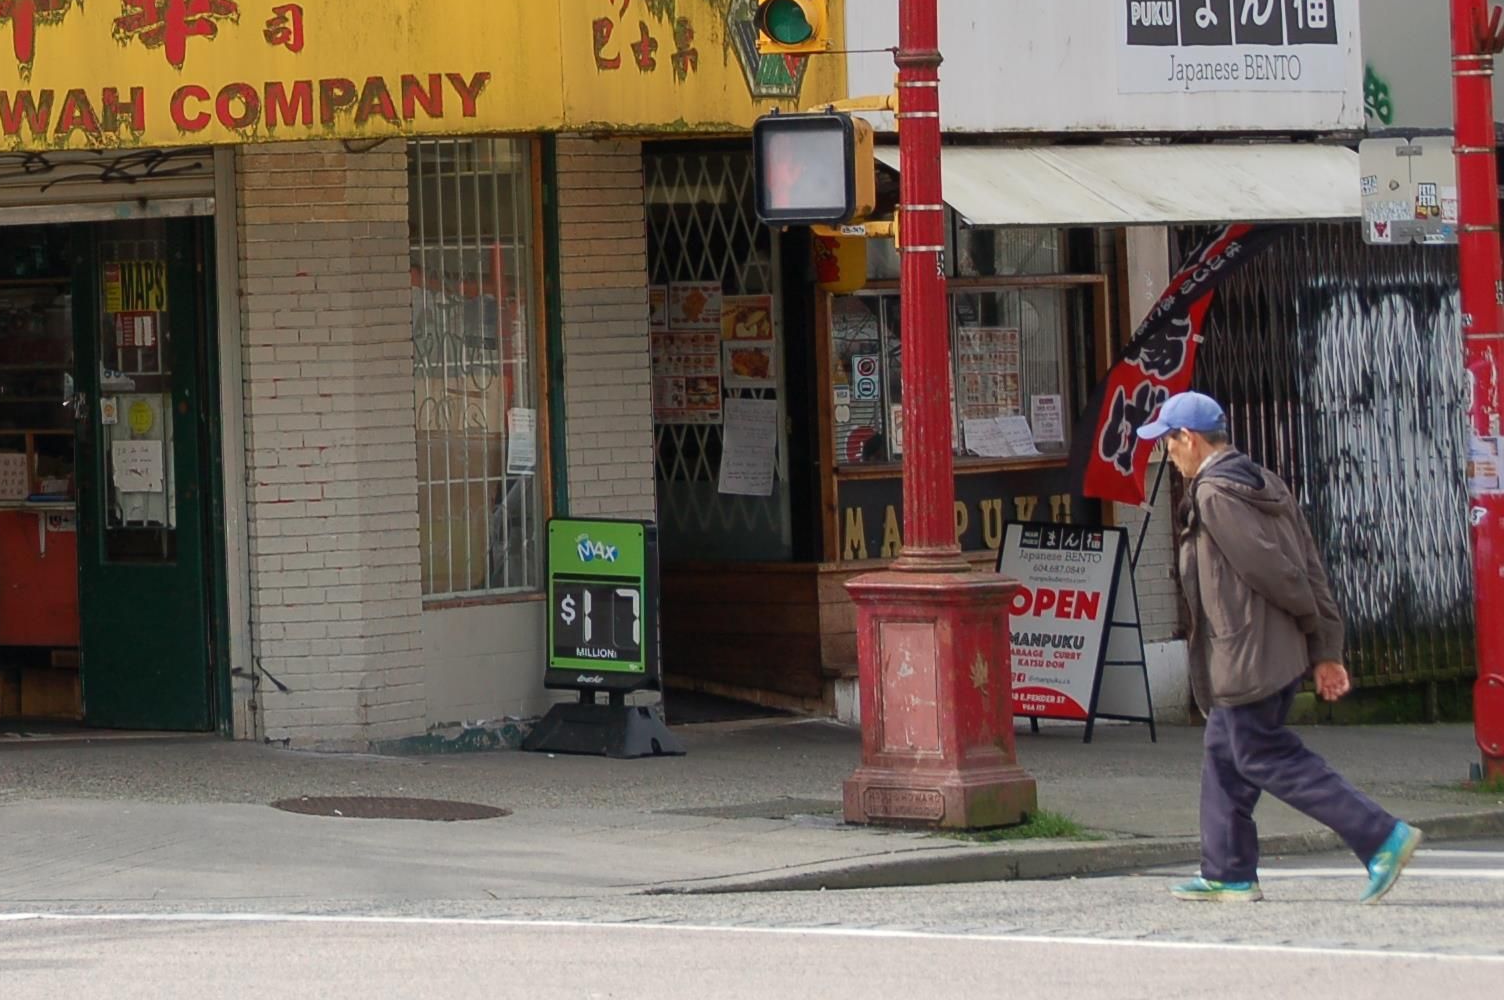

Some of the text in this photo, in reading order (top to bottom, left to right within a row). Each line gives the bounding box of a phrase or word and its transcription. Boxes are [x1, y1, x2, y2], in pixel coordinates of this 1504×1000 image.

[1131, 0, 1174, 27] PUKU
[1168, 54, 1302, 90] Japanese BENTO
[170, 72, 492, 132] COMPANY
[121, 263, 164, 311] MAPS
[843, 493, 1072, 560] MAPUKU
[578, 540, 617, 563] MAX
[1019, 550, 1102, 564] Japanese BENTO
[1008, 585, 1101, 621] OPEN
[1010, 648, 1043, 658] ARAAGE
